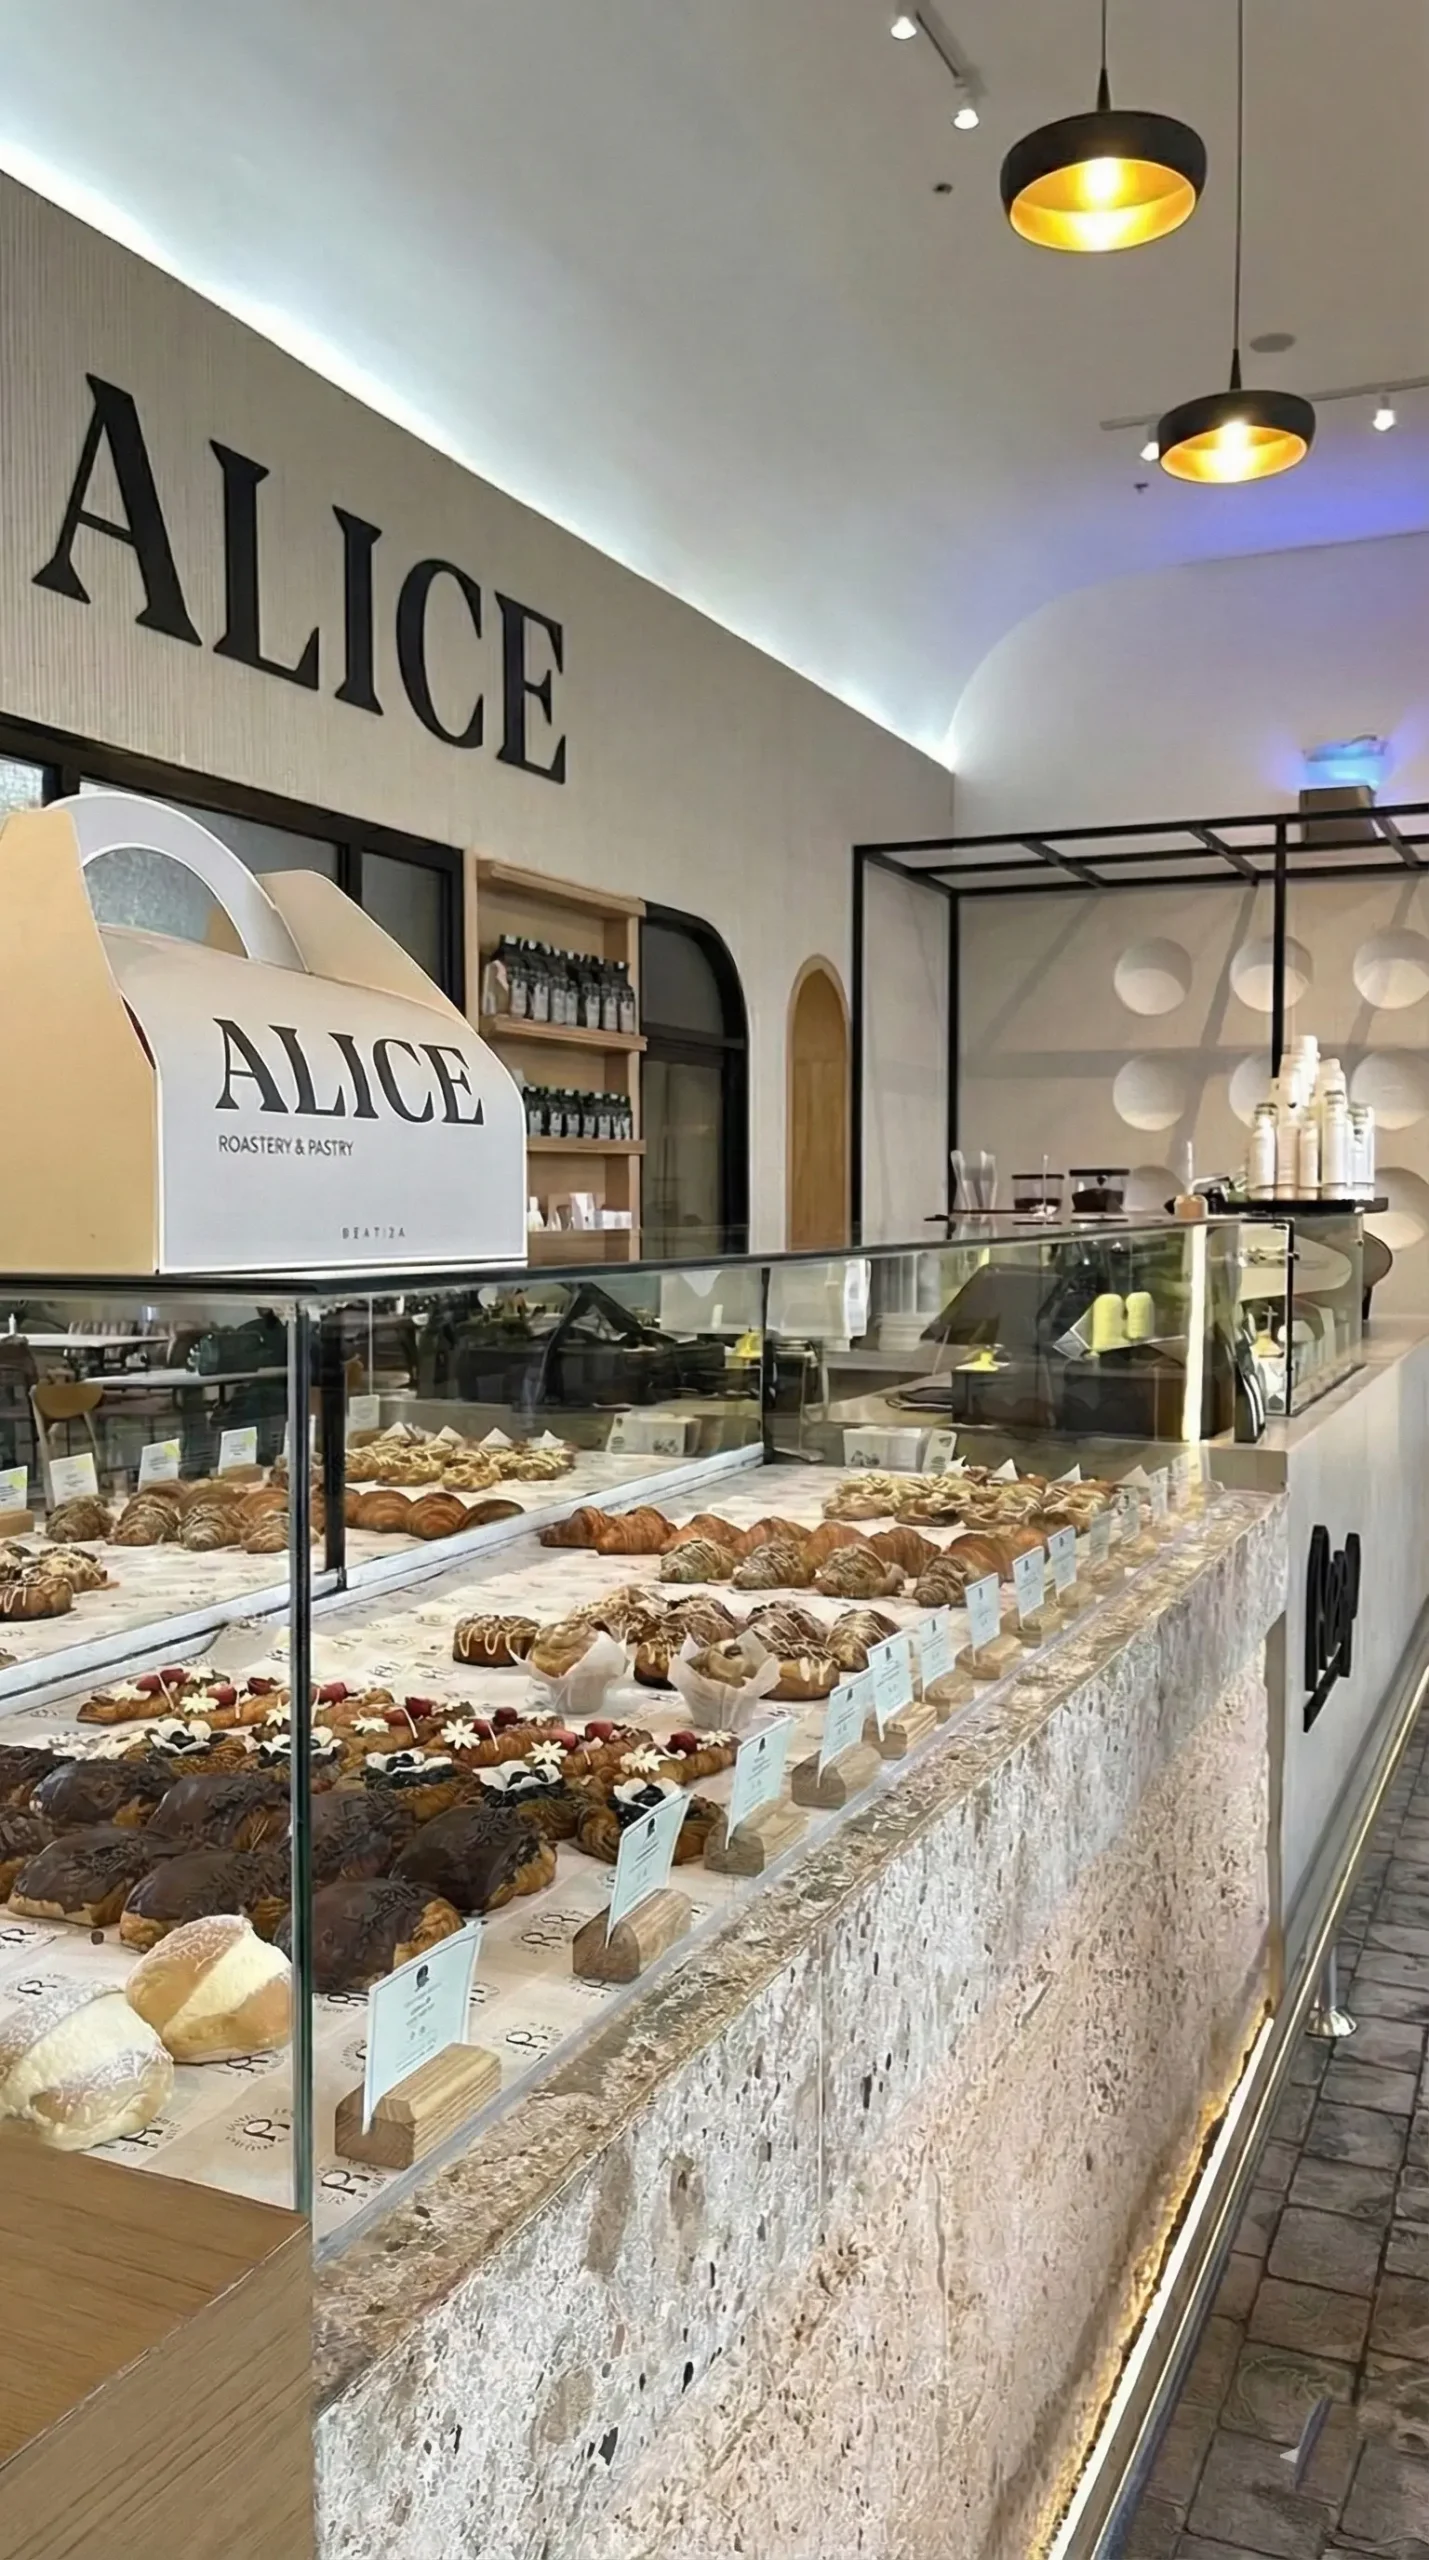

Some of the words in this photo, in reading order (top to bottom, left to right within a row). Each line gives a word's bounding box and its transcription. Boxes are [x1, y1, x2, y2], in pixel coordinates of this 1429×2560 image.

[31, 372, 566, 785] ALICE
[212, 1017, 484, 1126] ALICE
[218, 1134, 292, 1155] ROASTERY
[295, 1138, 306, 1156] &
[308, 1139, 354, 1157] PASTRY
